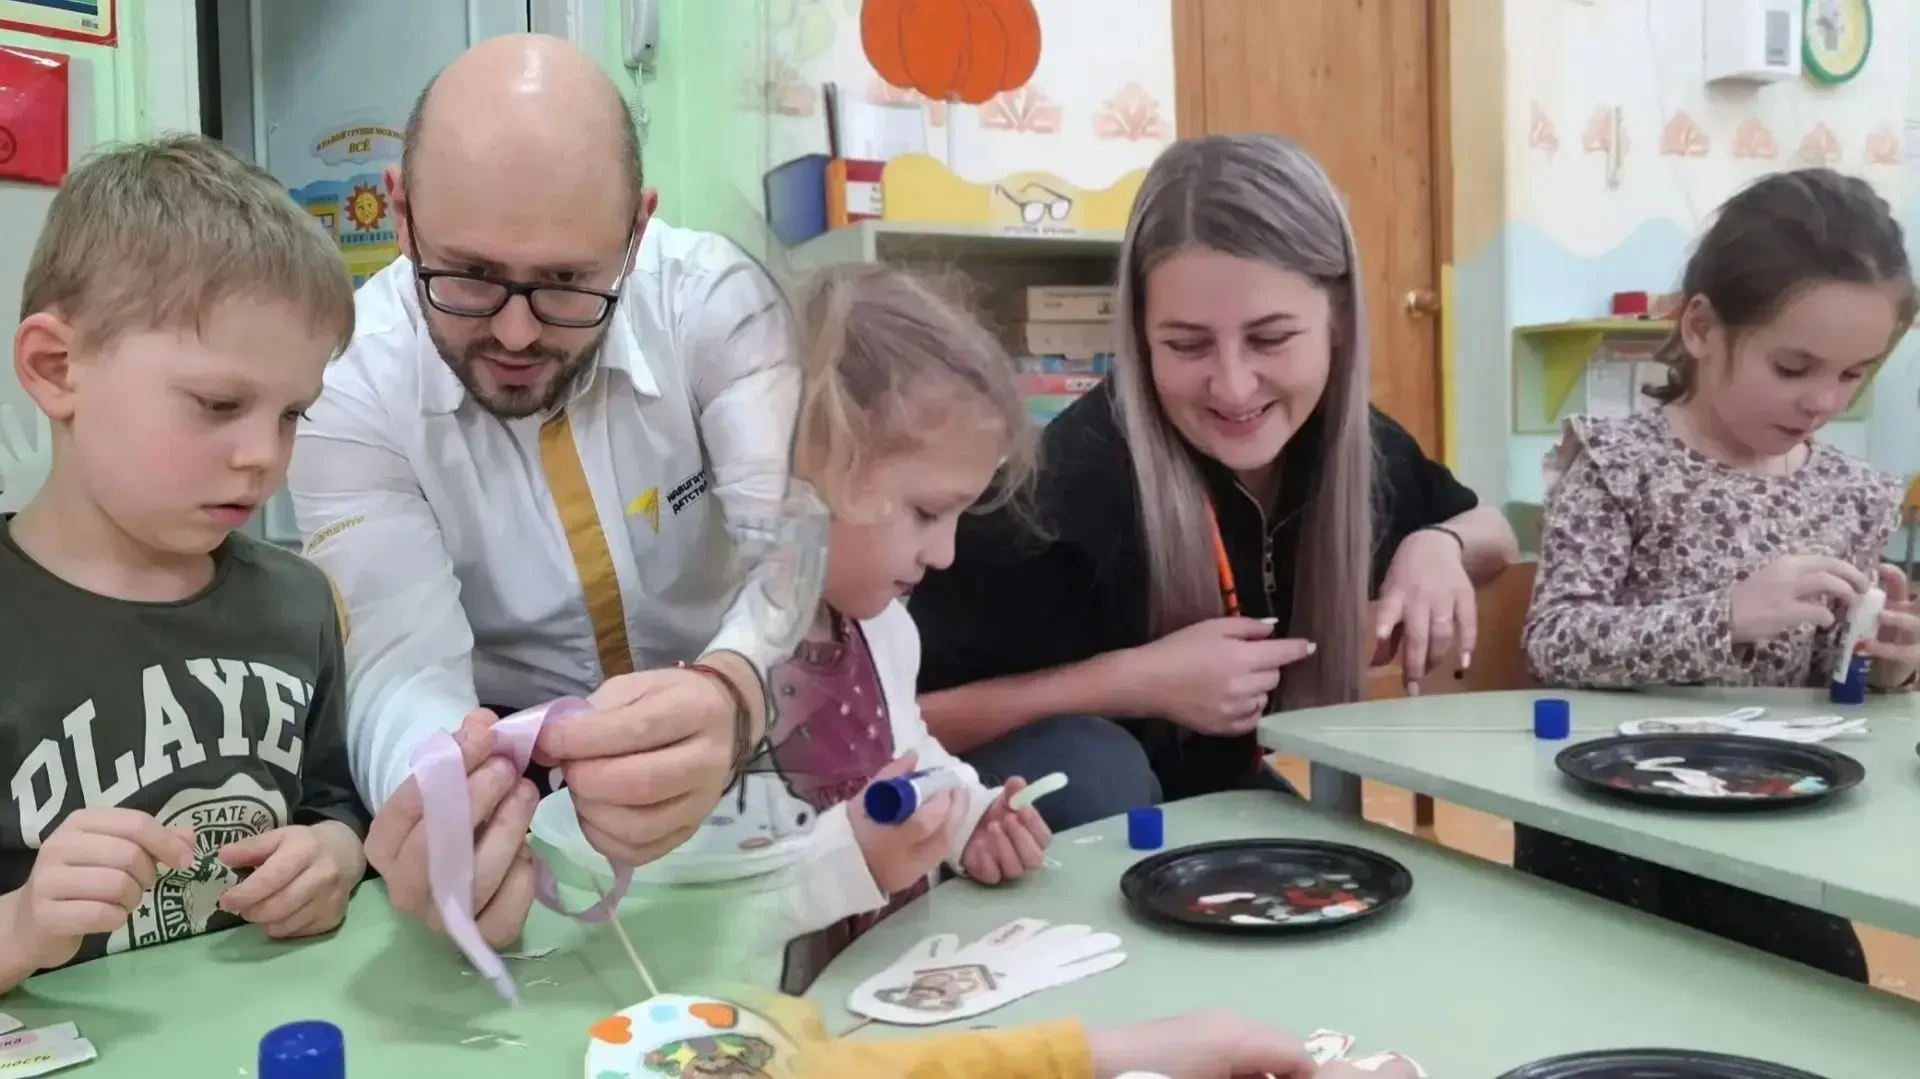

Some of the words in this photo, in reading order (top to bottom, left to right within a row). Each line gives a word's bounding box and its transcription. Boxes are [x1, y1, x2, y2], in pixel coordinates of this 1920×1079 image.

[348, 138, 371, 153] ВСЁ
[11, 658, 314, 849] PLAYE
[191, 805, 248, 827] STATE
